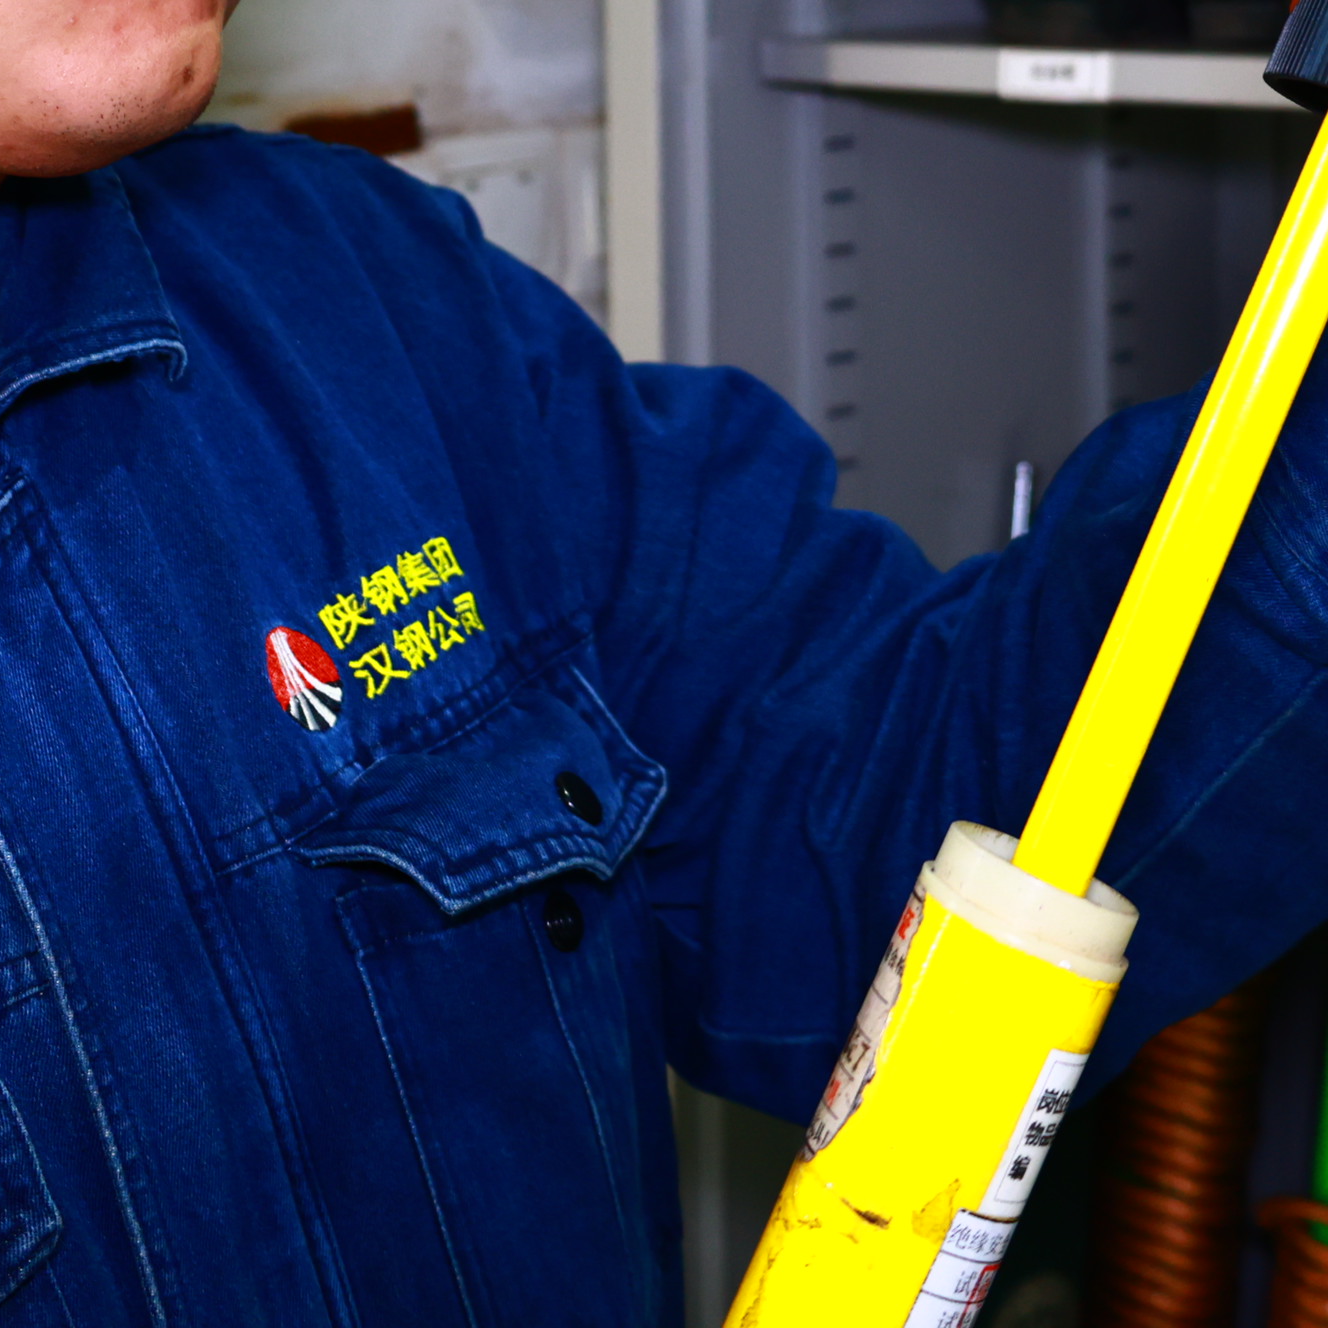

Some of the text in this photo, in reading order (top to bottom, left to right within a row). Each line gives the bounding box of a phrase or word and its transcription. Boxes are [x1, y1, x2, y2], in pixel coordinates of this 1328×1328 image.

[318, 537, 464, 649] 陕钢集团
[349, 592, 485, 698] 汉钢公司
